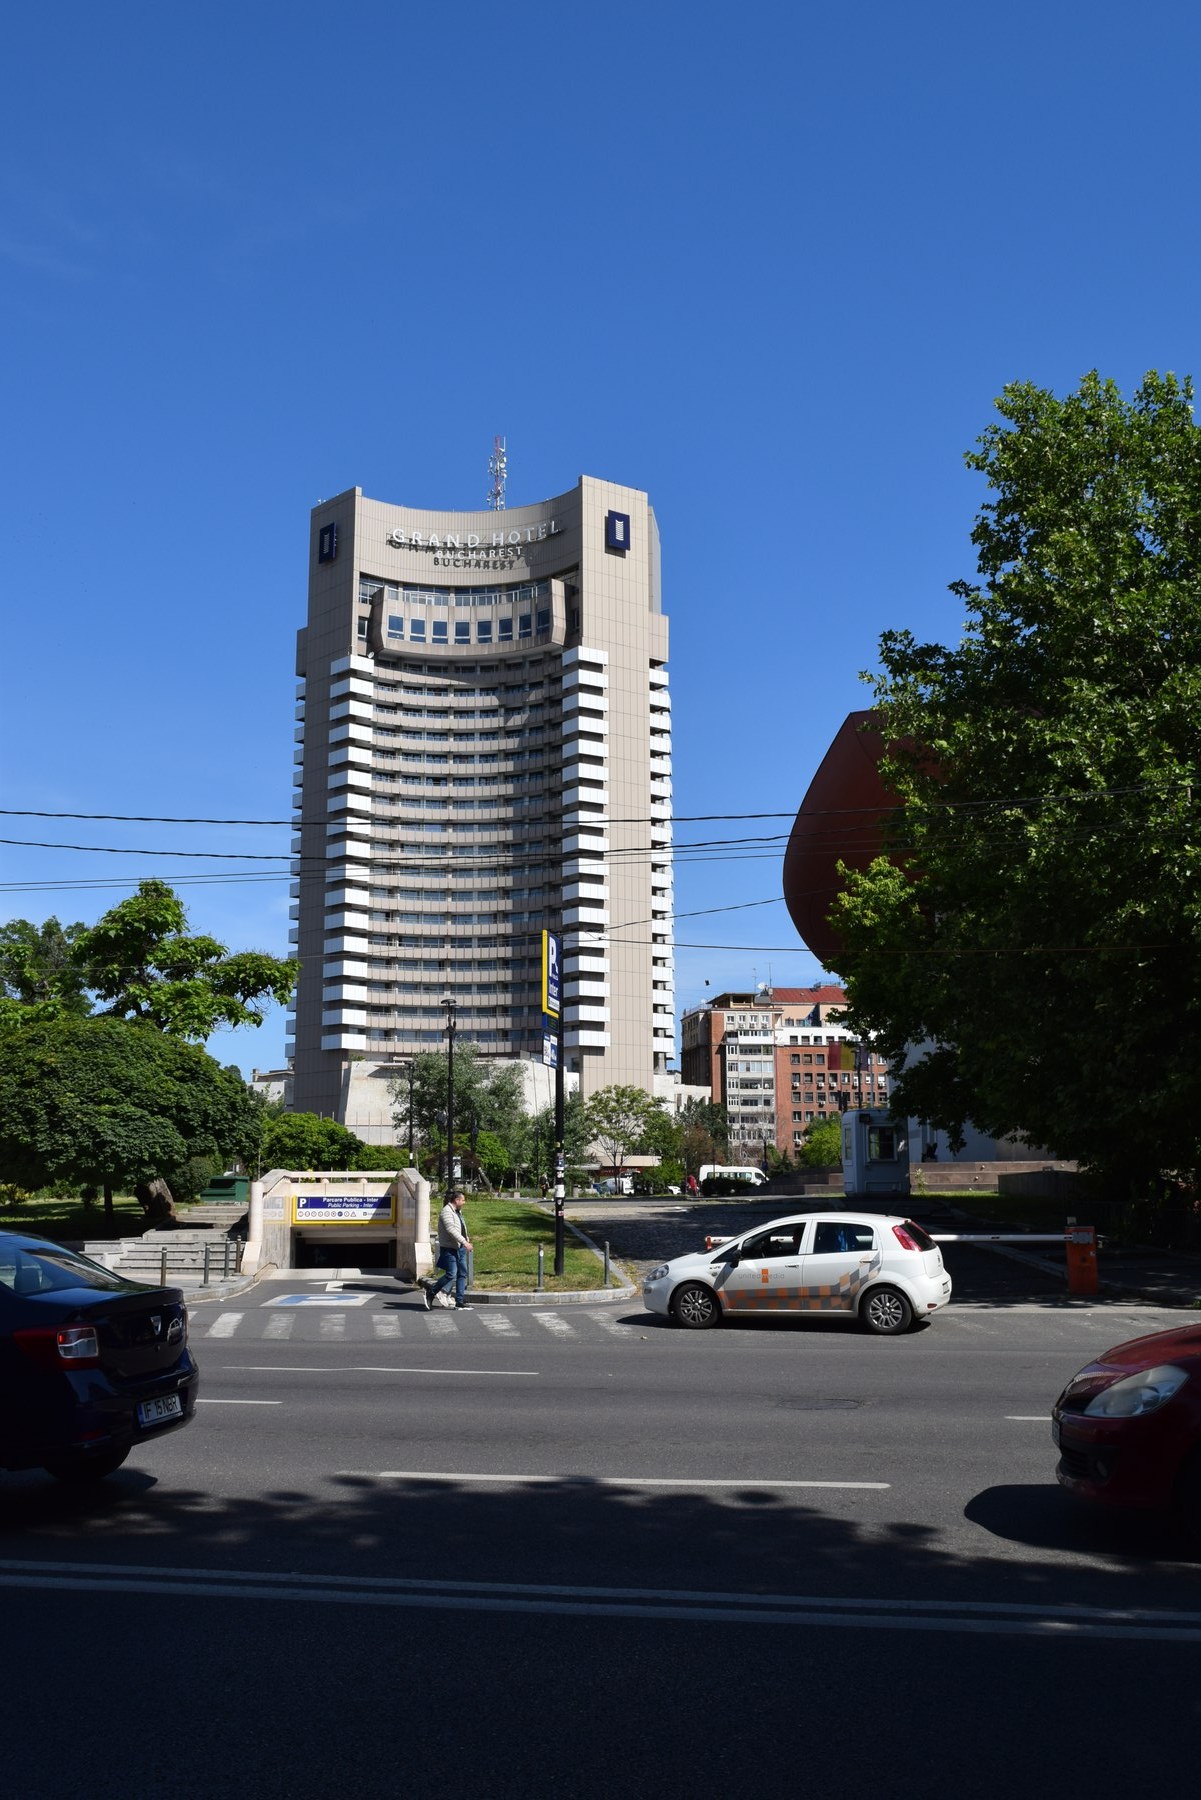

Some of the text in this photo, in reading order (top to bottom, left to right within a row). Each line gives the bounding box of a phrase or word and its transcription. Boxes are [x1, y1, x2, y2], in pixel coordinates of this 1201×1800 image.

[392, 520, 560, 548] GRAND HOTEL
[436, 546, 523, 560] BUCHAREST
[548, 980, 559, 997] Inter
[299, 1198, 307, 1208] P
[143, 1402, 152, 1419] IF
